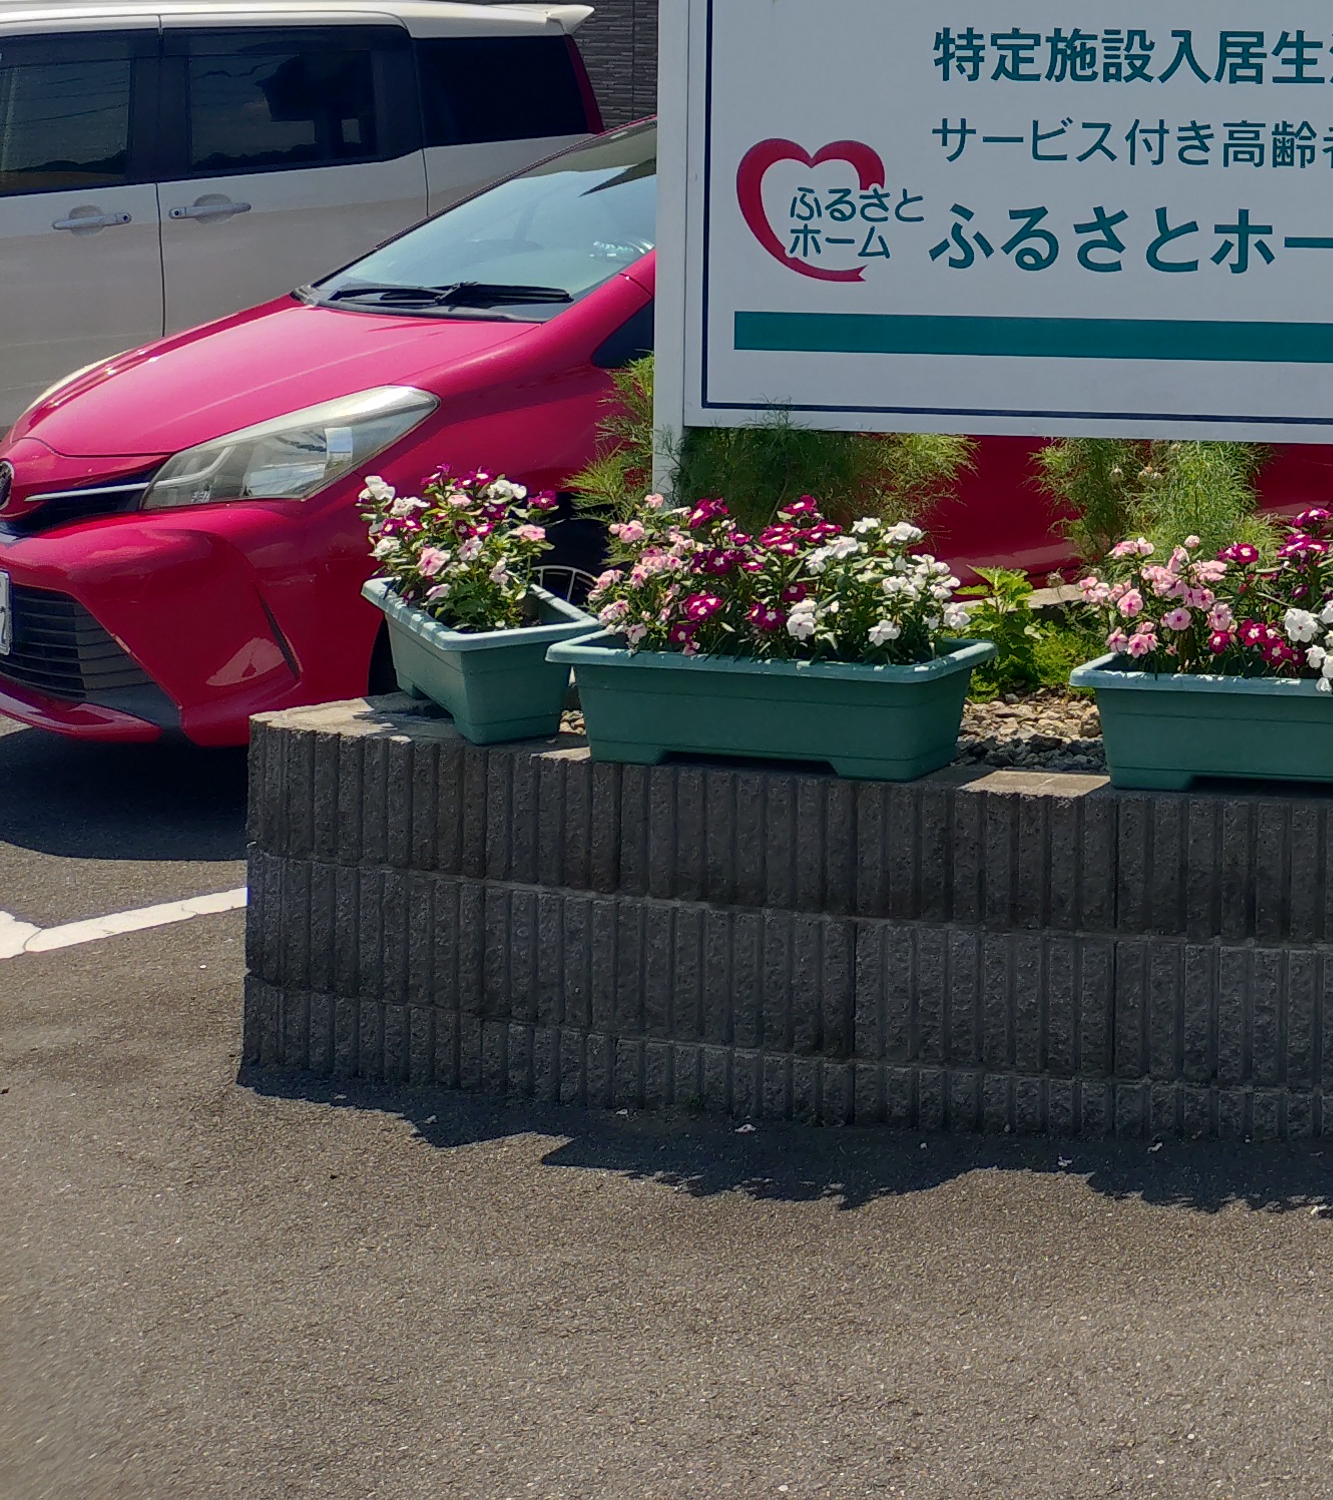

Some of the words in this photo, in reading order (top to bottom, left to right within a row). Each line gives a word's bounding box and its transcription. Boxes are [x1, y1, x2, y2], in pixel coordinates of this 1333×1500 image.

[790, 187, 925, 222] ふるさと
[790, 223, 891, 259] ホーム
